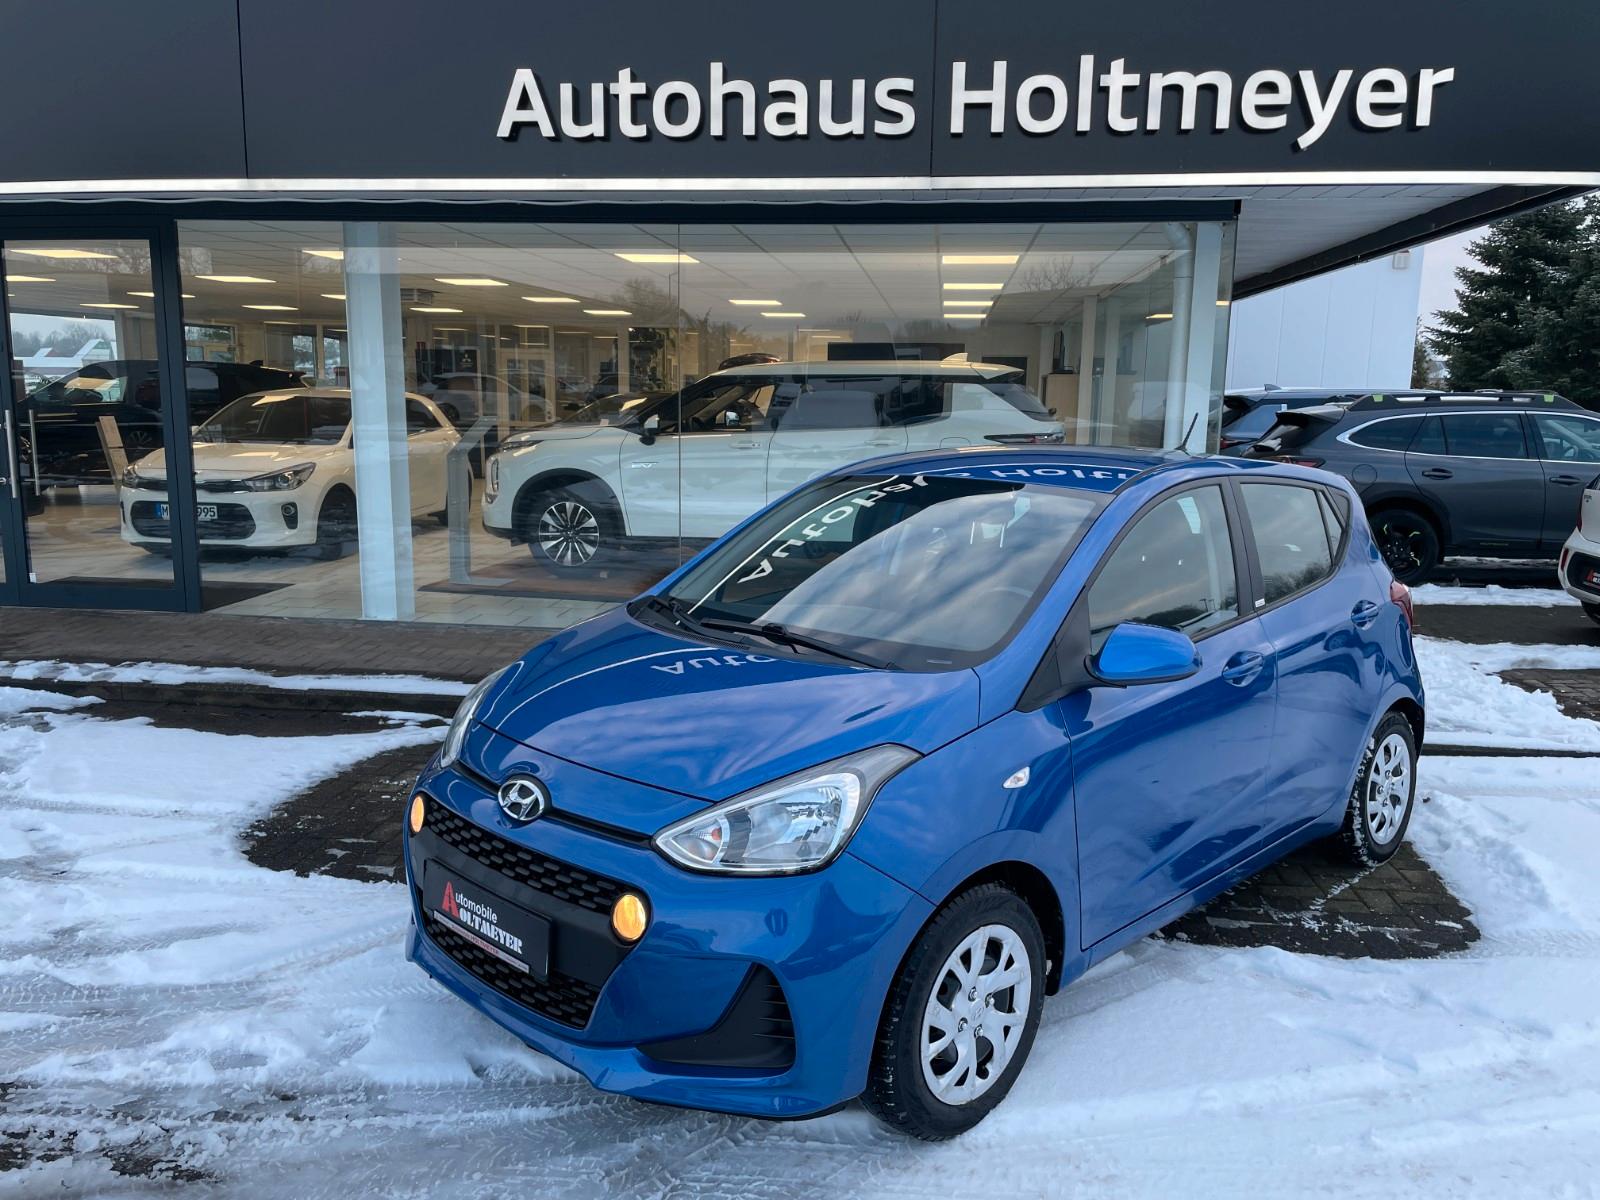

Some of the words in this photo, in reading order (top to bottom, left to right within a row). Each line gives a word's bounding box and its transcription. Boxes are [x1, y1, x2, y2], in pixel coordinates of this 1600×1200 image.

[496, 61, 916, 139] Autohaus
[950, 54, 1455, 150] Holtmeyer
[441, 880, 498, 924] Automobile
